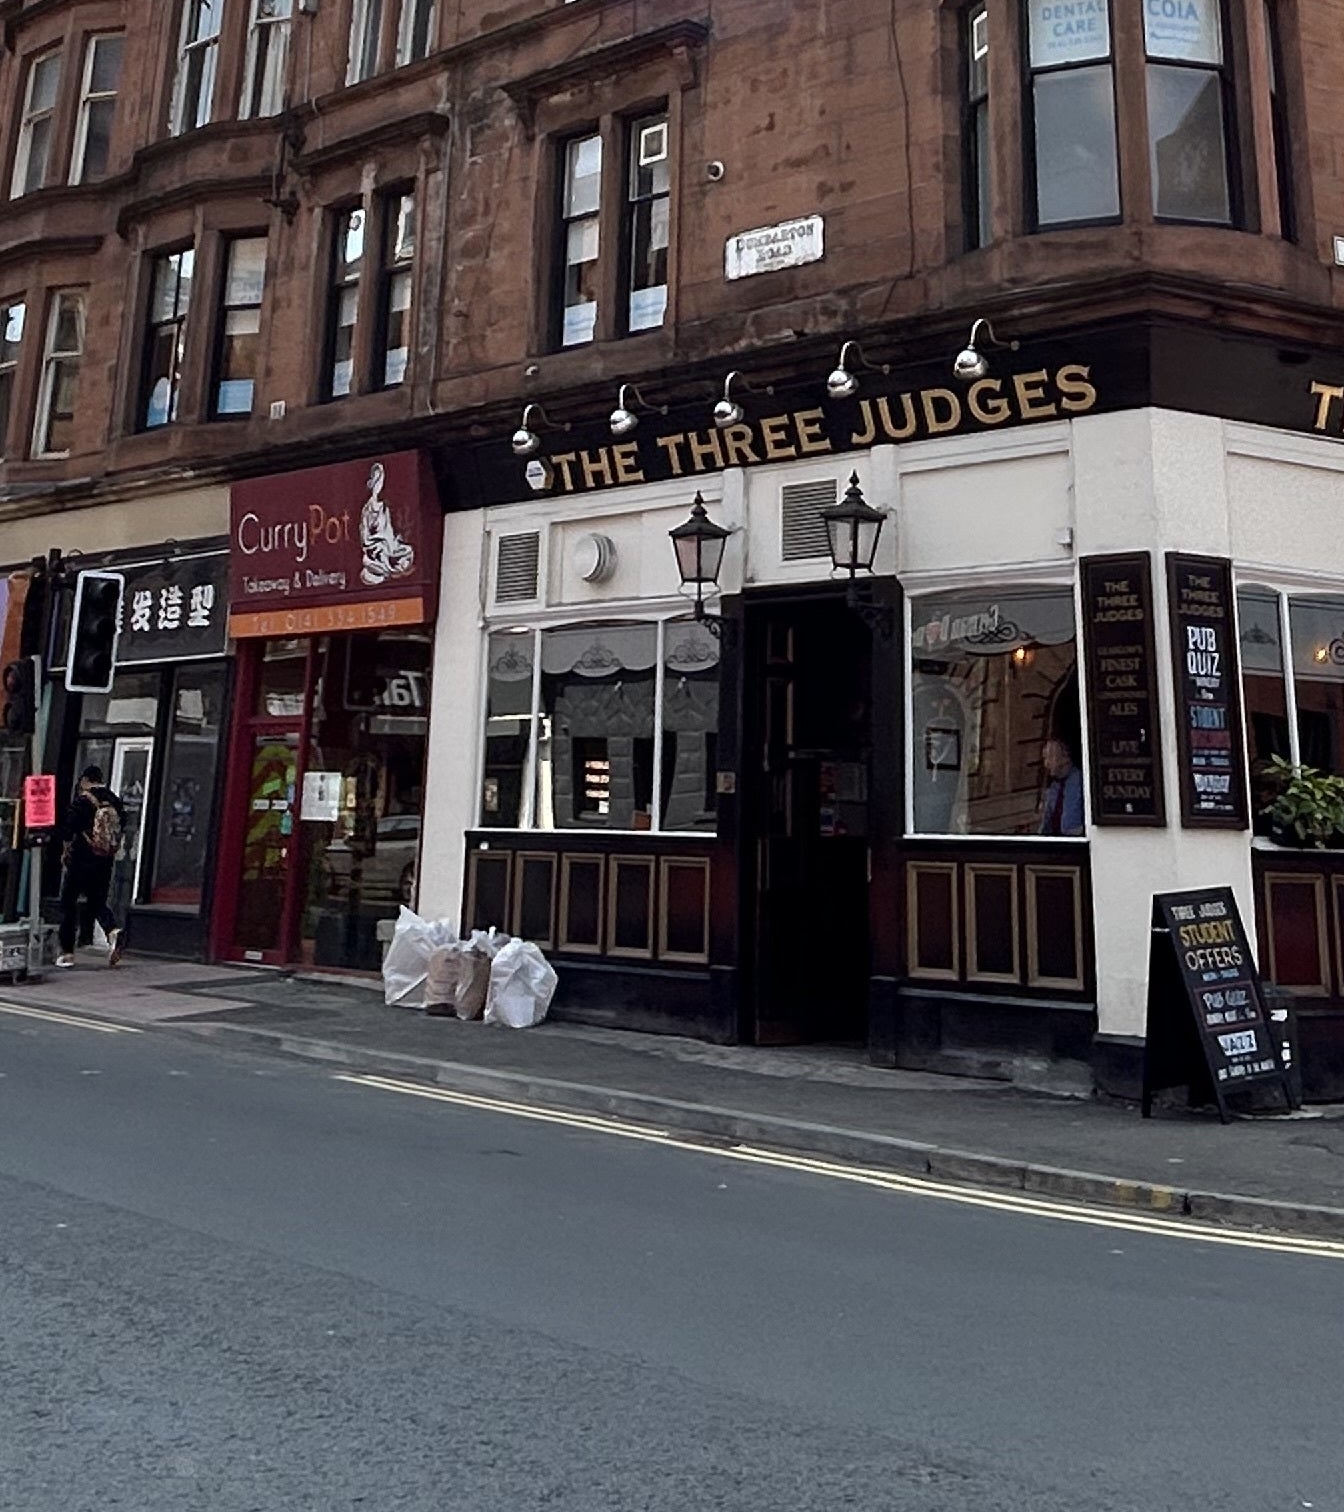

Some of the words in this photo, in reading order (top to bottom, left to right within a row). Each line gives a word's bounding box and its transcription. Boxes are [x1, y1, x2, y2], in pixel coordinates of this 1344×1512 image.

[1042, 0, 1106, 20] DENTAL
[1053, 18, 1097, 36] CARE
[550, 441, 645, 491] THE
[657, 408, 832, 476] THREE
[851, 364, 1097, 444] JUDGES
[242, 576, 290, 595] Takeaway
[294, 571, 302, 588] &
[306, 569, 346, 589] Delivery
[1104, 581, 1130, 593] THE
[1097, 595, 1139, 608] THREE
[1094, 609, 1144, 622] JUDGES
[1186, 626, 1217, 652] PUB
[1186, 651, 1222, 676] QUIZ
[1179, 920, 1235, 947] STUDENT
[1185, 945, 1243, 971] OFFERS
